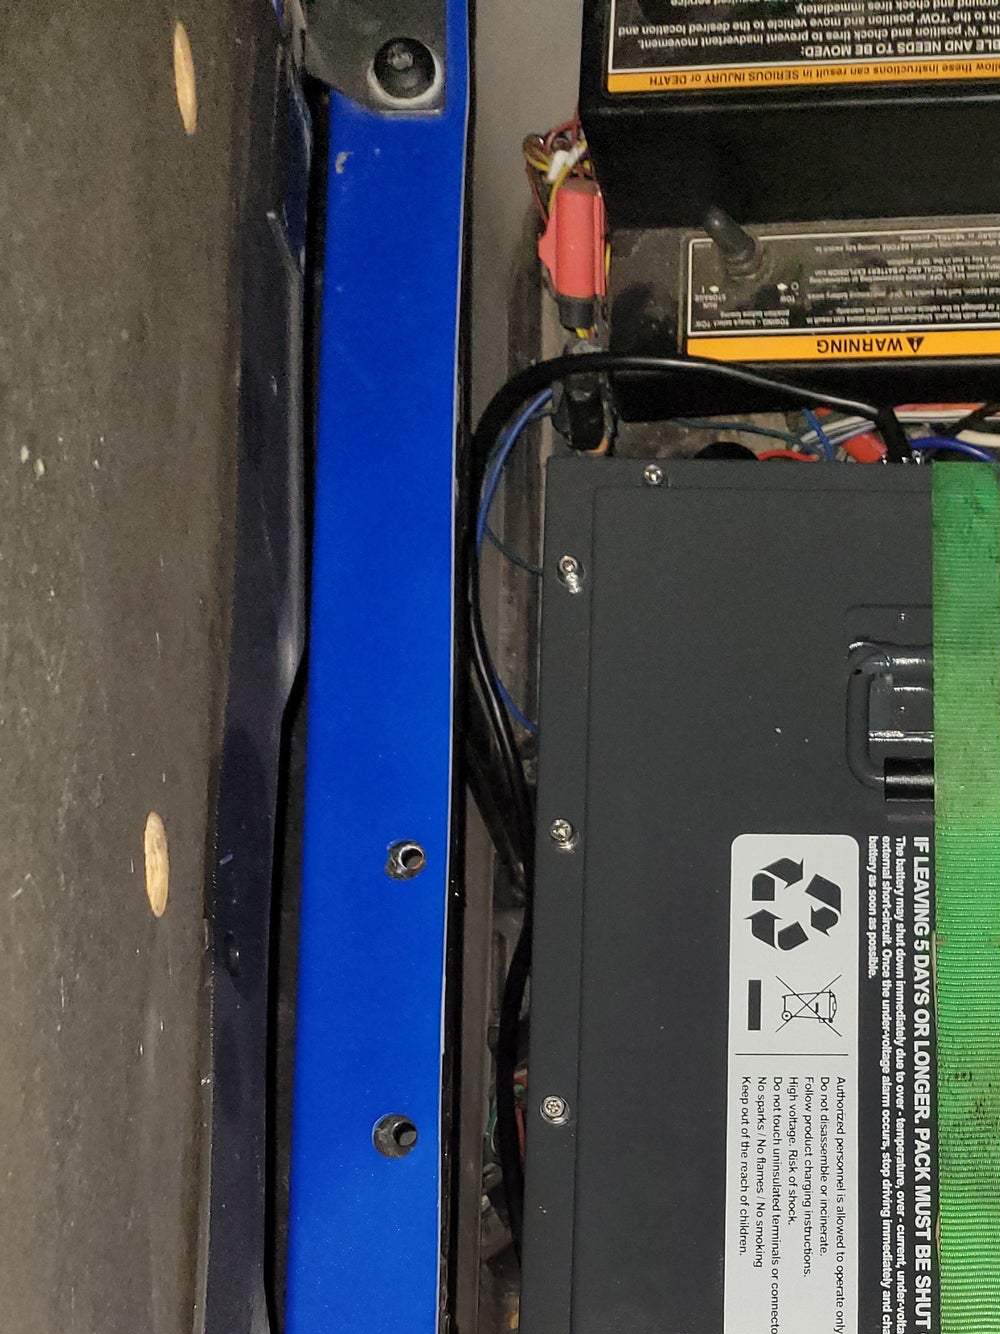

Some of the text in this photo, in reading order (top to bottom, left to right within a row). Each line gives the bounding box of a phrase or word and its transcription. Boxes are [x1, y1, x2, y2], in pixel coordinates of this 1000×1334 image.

[638, 36, 698, 49] movement.
[702, 35, 763, 47] inadvertent
[767, 31, 808, 43] prevent
[812, 32, 823, 42] to
[827, 31, 851, 42] tires
[855, 29, 888, 41] chock
[892, 29, 912, 39] and
[916, 25, 961, 38] position
[983, 26, 1000, 36] the
[801, 45, 851, 57] MOVED:
[856, 44, 872, 56] BE
[877, 43, 893, 54] TO
[898, 42, 941, 54] NEEDS
[946, 41, 972, 52] AND
[649, 75, 687, 85] DEATH
[705, 72, 745, 83] INJURY
[749, 70, 799, 81] SERIOUS
[804, 70, 812, 78] in
[817, 69, 847, 78] result
[874, 65, 938, 75] instructions
[943, 64, 972, 74] these
[818, 338, 902, 353] WARNING
[896, 836, 906, 856] The
[914, 837, 929, 852] IF
[883, 836, 892, 878] external
[892, 858, 906, 895] battery
[867, 836, 879, 978] battery as soon as possible.
[914, 857, 930, 935] LEAVING
[883, 881, 892, 946] short-circuit.
[892, 898, 904, 920] may
[892, 923, 906, 946] shut
[914, 940, 930, 950] 5
[883, 949, 892, 977] Once
[892, 948, 906, 977] down
[883, 980, 892, 997] the
[915, 955, 930, 1004] DAYS
[894, 981, 906, 1046] immediately
[915, 1009, 930, 1036] OR
[880, 1000, 892, 1073] under-voltage
[897, 1048, 906, 1068] due
[758, 1077, 767, 1091] No
[774, 1077, 783, 1090] Do
[896, 1071, 906, 1082] to
[915, 1041, 930, 1123] LONGER.
[774, 1094, 782, 1110] not
[883, 1076, 892, 1106] alarm
[896, 1085, 904, 1109] over
[756, 1095, 766, 1129] sparks
[837, 1077, 846, 1134] Authorized
[774, 1115, 782, 1144] touch
[881, 1109, 890, 1149] occurs,
[758, 1139, 766, 1153] No
[787, 1077, 798, 1225] High voltage. Risk of shock.
[895, 1118, 906, 1187] temperature,
[915, 1128, 931, 1180] PACK
[740, 1077, 751, 1255] Keep out of the reach of children.
[757, 1157, 766, 1193] flames
[820, 1077, 830, 1256] Do not disassemble or incinerate.
[837, 1138, 845, 1190] personnel
[881, 1152, 892, 1176] stop
[773, 1148, 782, 1210] uninsulated
[803, 1077, 814, 1277] Follow product charging instructions.
[837, 1194, 846, 1202] is
[881, 1179, 893, 1216] driving
[897, 1191, 905, 1216] over
[757, 1202, 765, 1217] No
[916, 1186, 931, 1240] MUST
[837, 1206, 846, 1247] allowed
[754, 1221, 765, 1267] smoking
[772, 1215, 781, 1264] terminals
[896, 1224, 906, 1267] current,
[837, 1252, 845, 1261] to
[881, 1219, 893, 1287] immediately
[916, 1245, 931, 1270] BE
[772, 1268, 779, 1278] or
[835, 1265, 845, 1307] operate
[883, 1290, 893, 1311] and
[916, 1275, 932, 1329] SHUT
